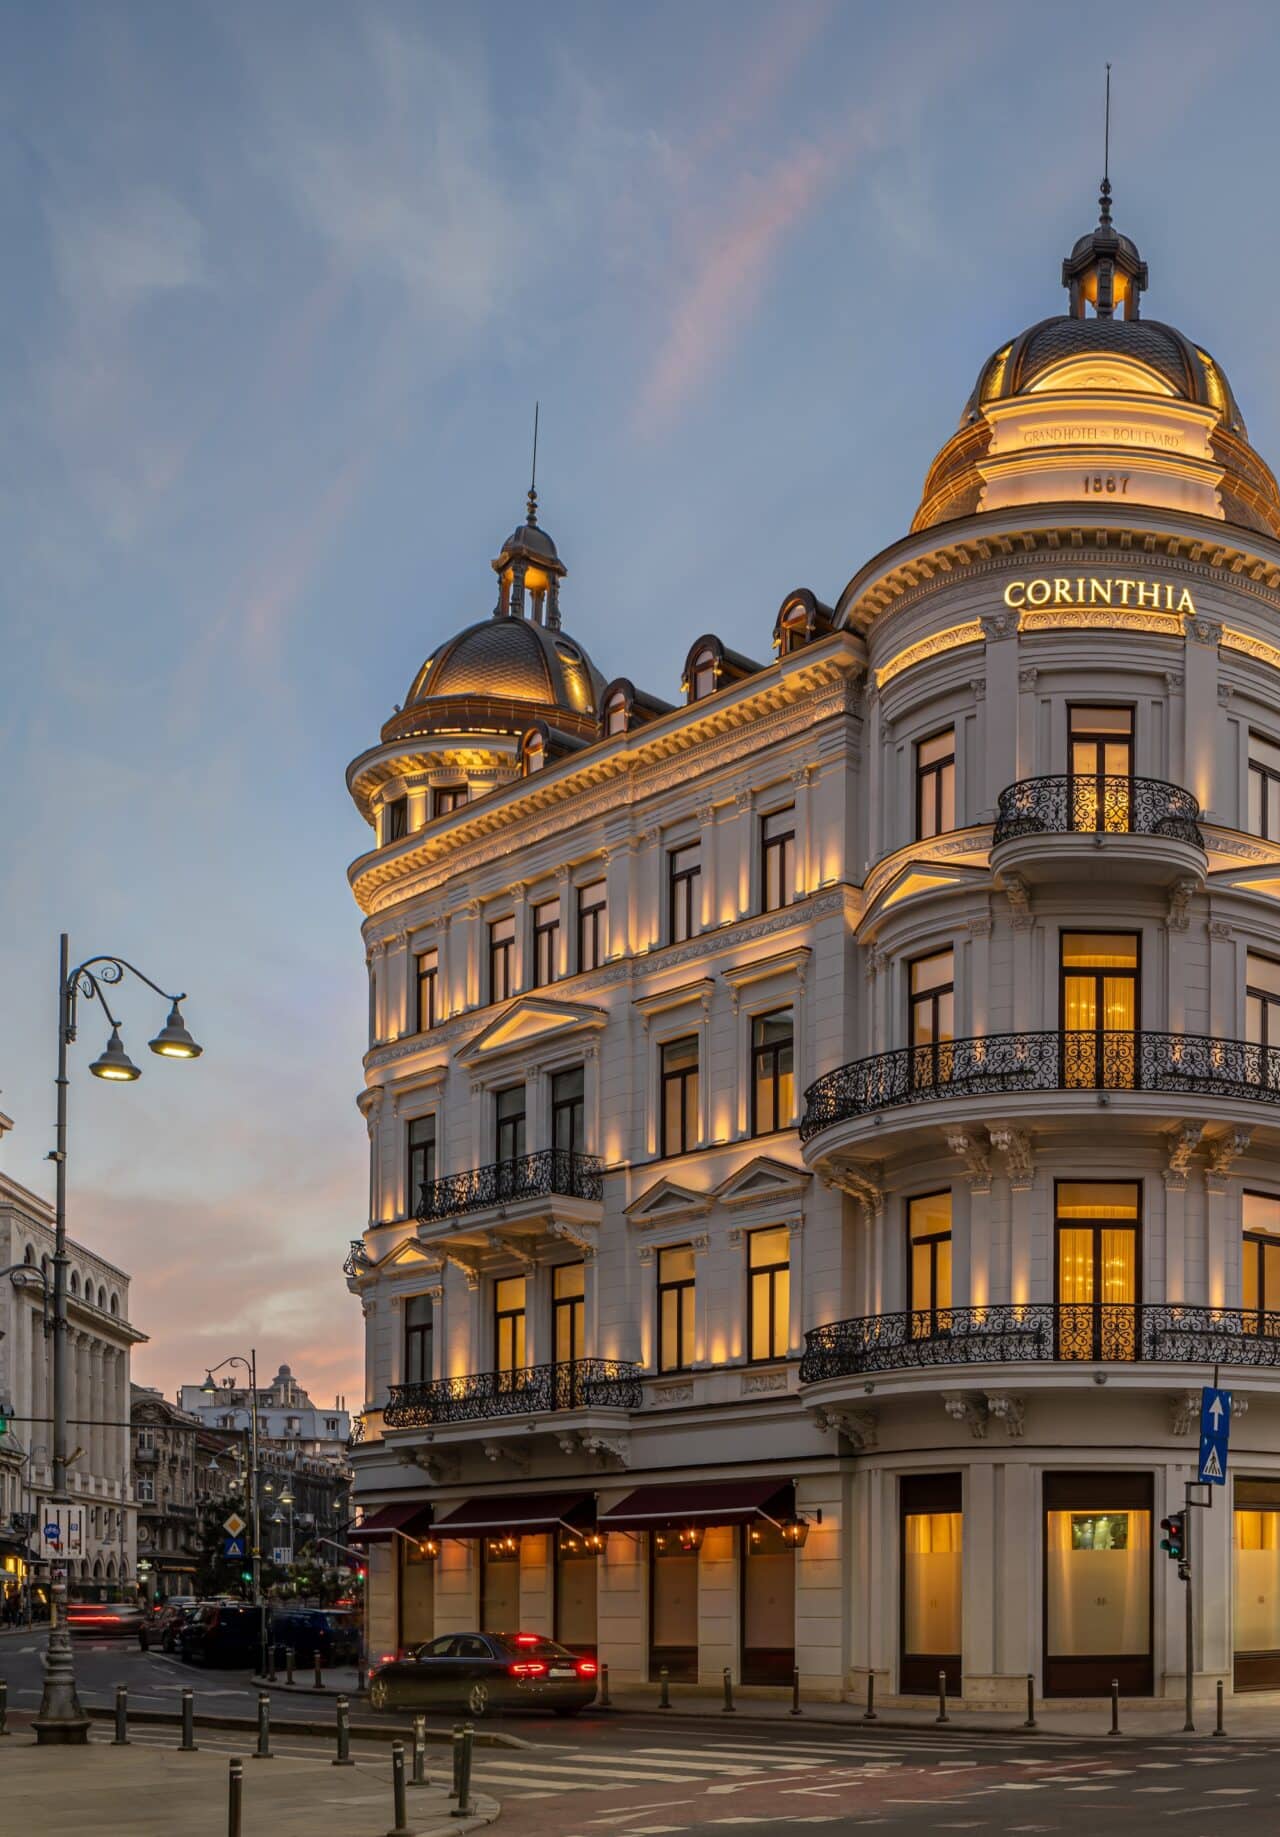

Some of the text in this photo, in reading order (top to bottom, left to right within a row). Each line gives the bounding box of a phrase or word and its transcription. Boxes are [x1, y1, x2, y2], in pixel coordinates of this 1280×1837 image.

[1023, 426, 1179, 448] GRAND HOTEL BOULEVARD
[1084, 473, 1130, 494] 1867
[1004, 578, 1196, 615] CORINTHIA
